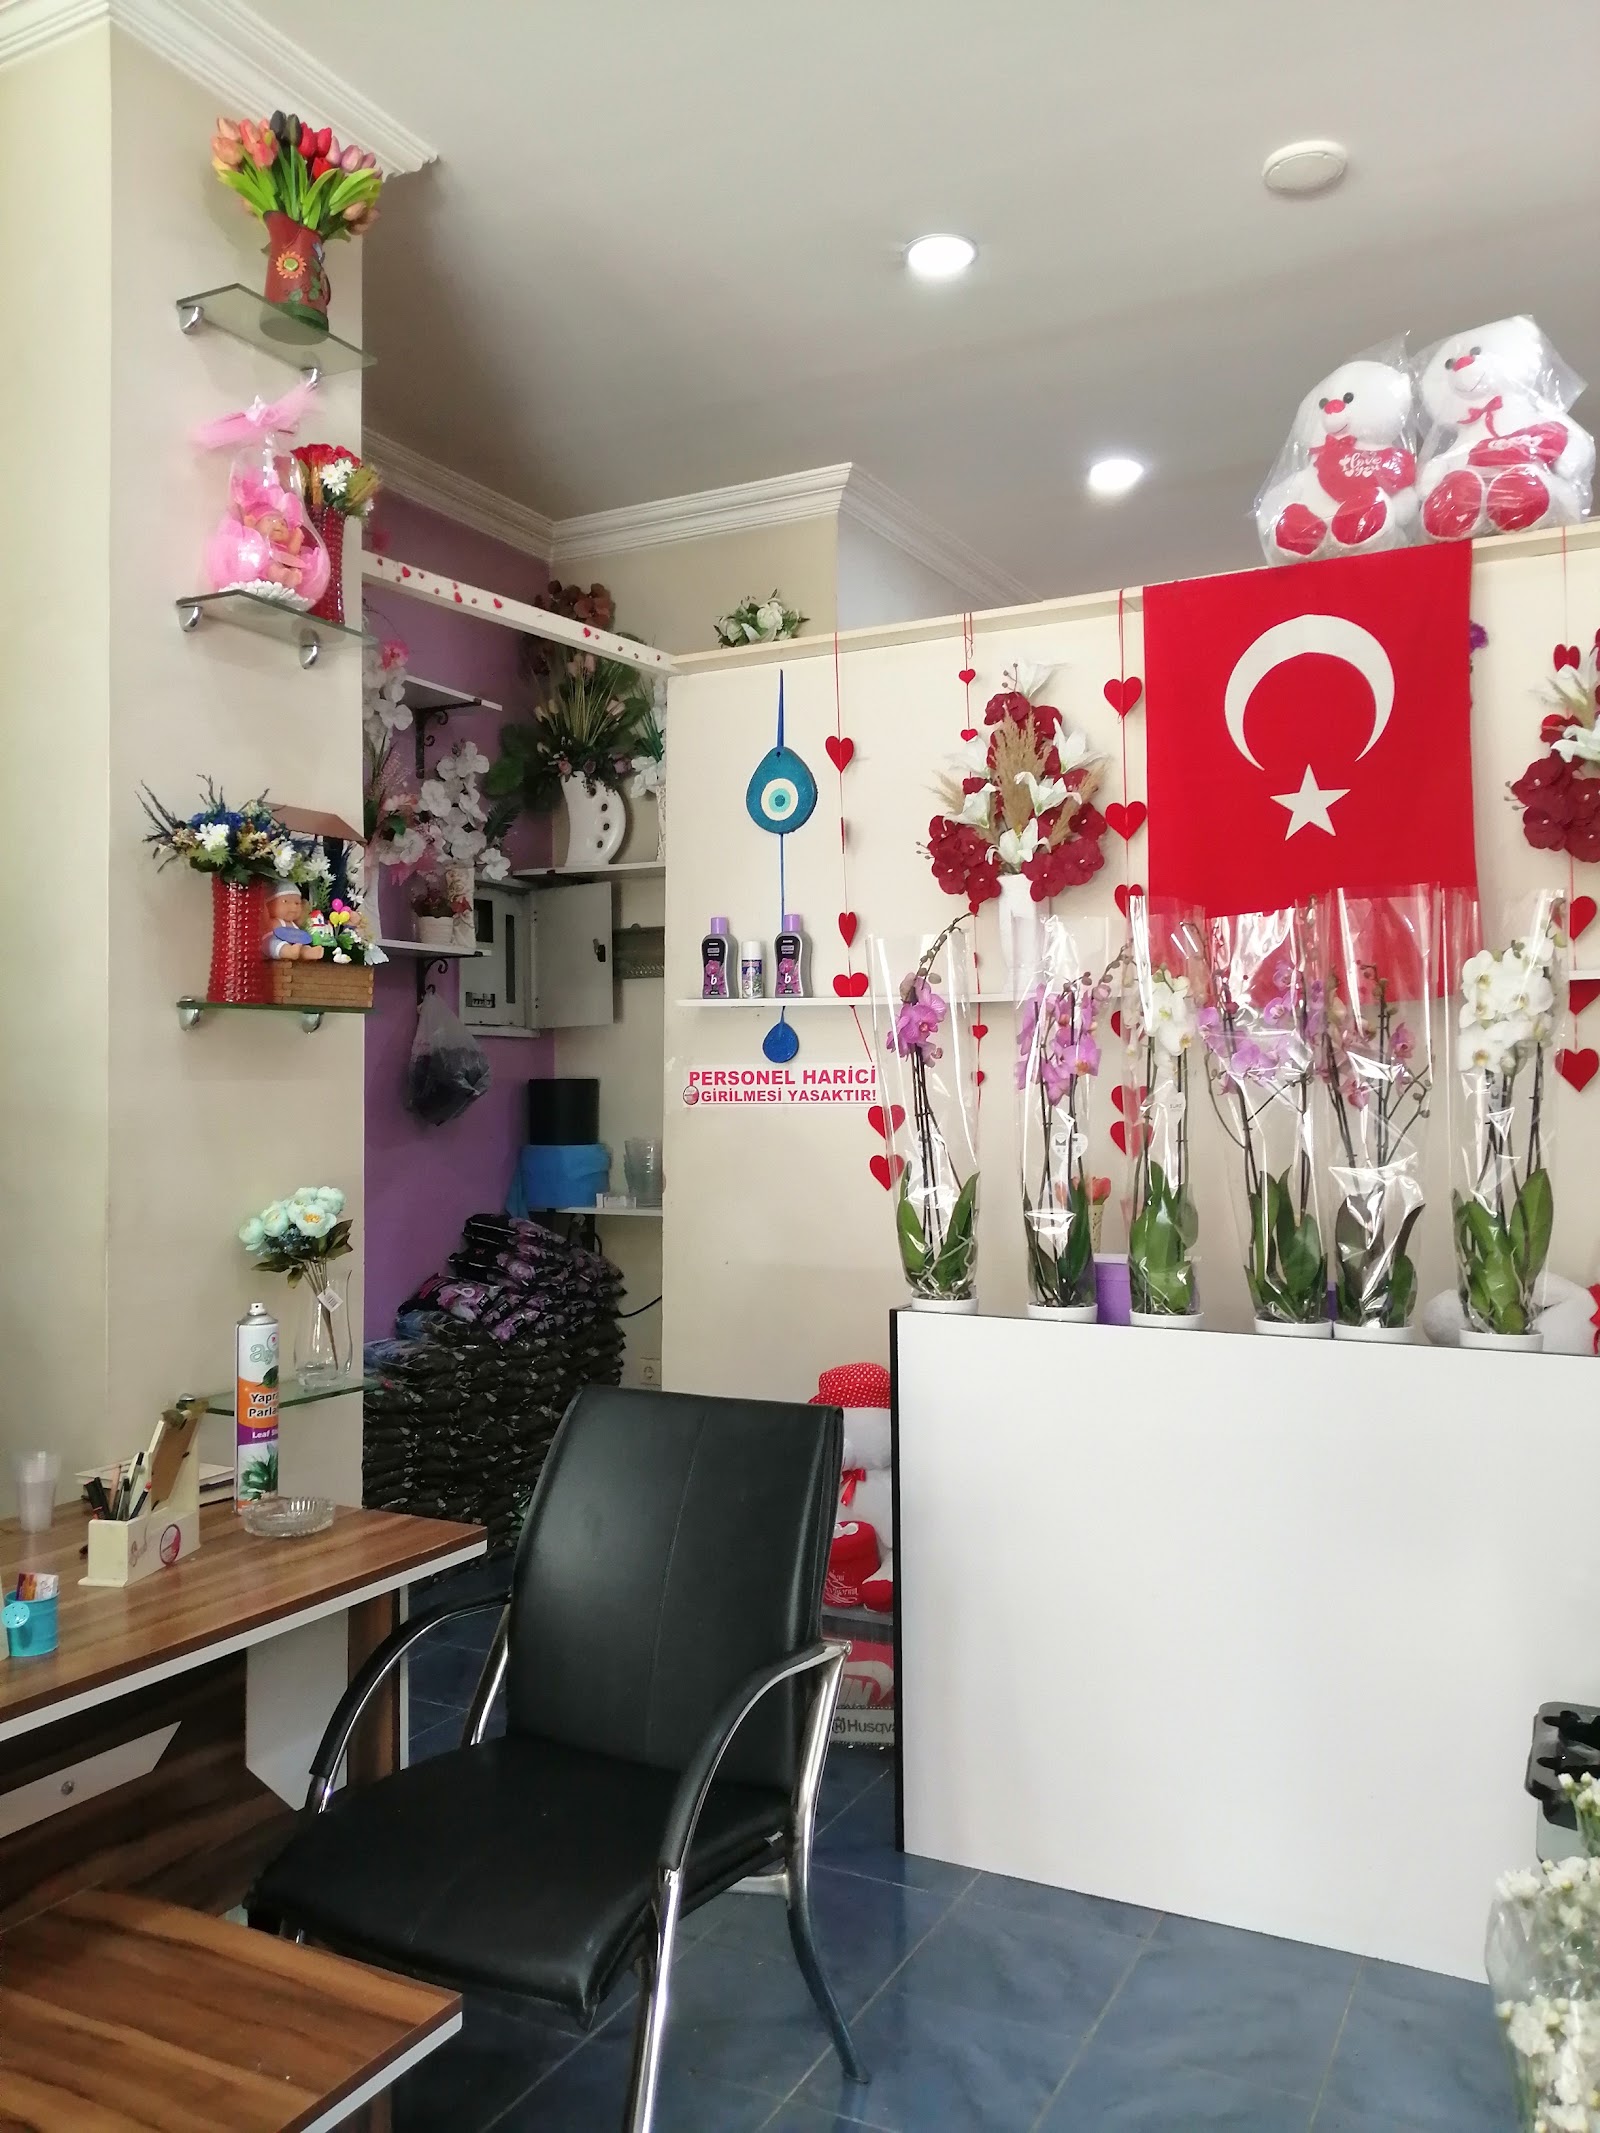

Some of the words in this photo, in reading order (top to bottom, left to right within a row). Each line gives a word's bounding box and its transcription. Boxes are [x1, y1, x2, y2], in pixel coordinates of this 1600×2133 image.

[690, 1070, 795, 1085] PERSONEL
[803, 1065, 876, 1084] HARİCİ
[701, 1087, 782, 1102] GİRİLMESİ
[788, 1089, 876, 1101] YASAKTIR!
[251, 1429, 271, 1439] Leaf
